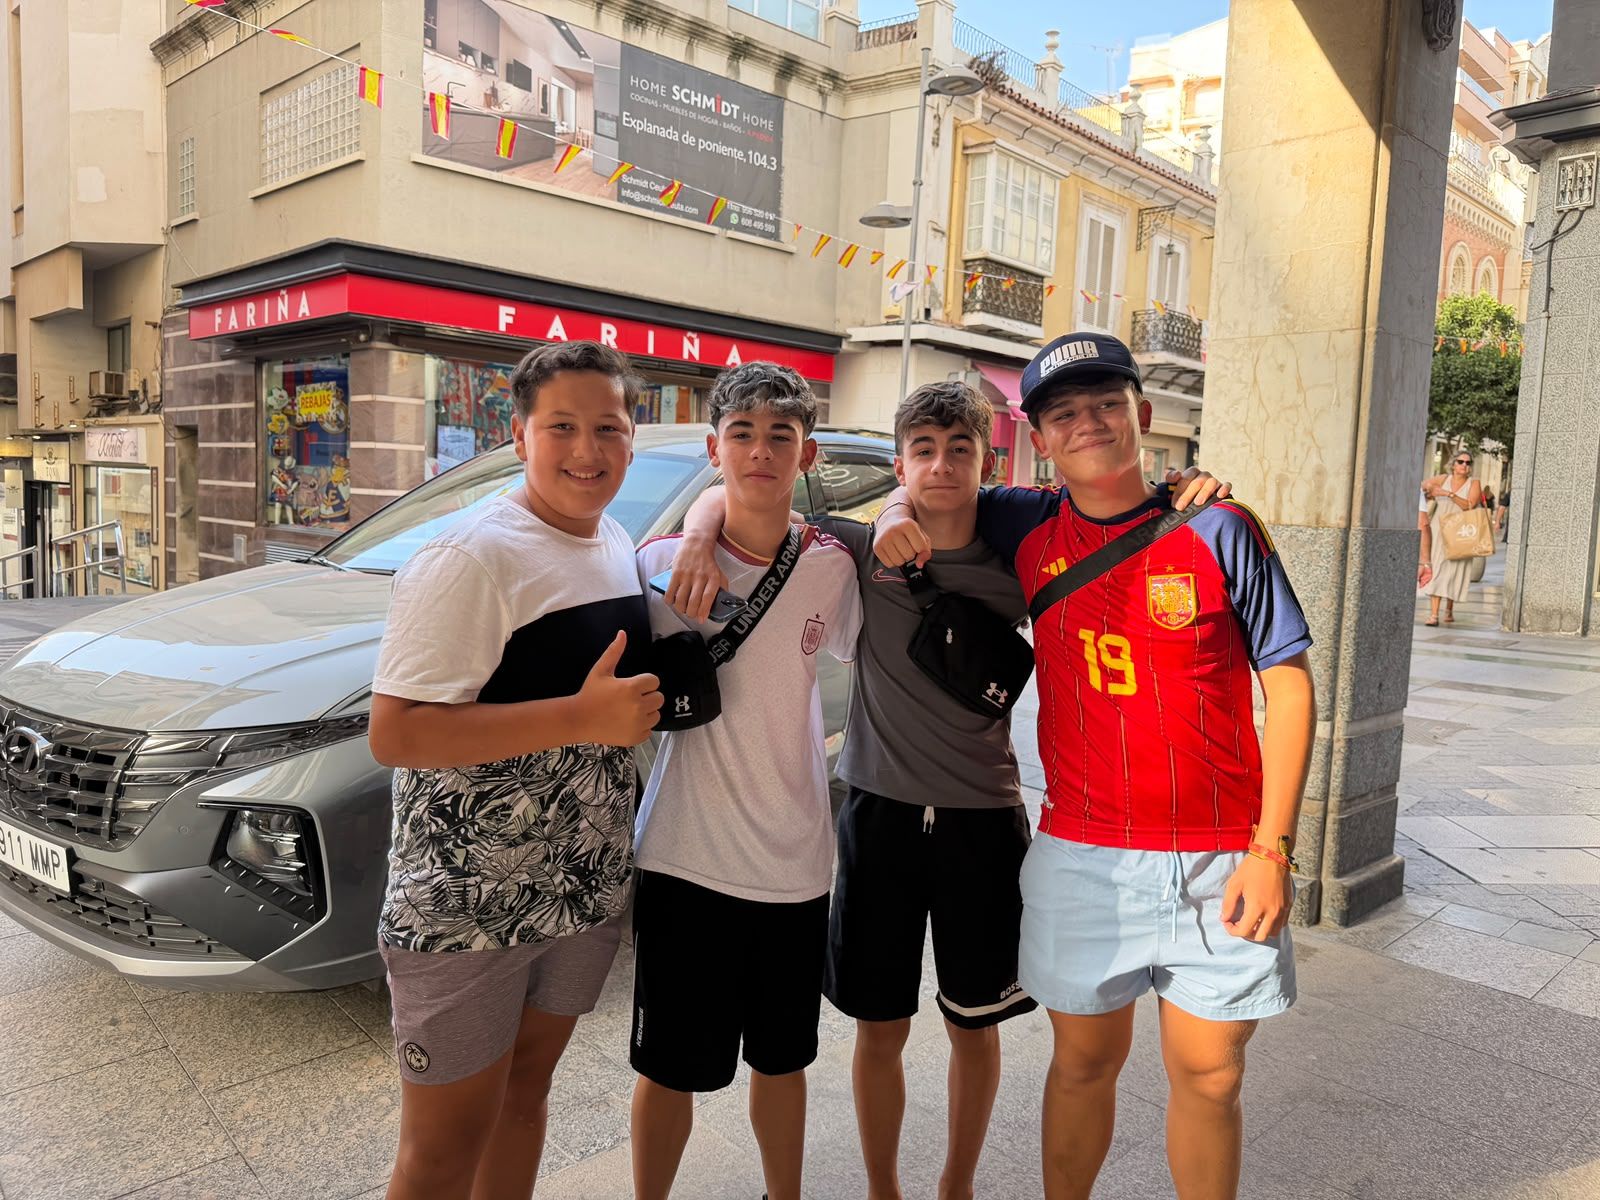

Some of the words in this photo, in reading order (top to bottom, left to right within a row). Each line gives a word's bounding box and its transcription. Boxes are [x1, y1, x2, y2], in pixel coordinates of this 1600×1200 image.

[630, 75, 667, 97] HOME
[742, 112, 775, 132] HOME
[630, 92, 659, 108] COCINAS
[662, 103, 688, 117] MUEBLES
[688, 111, 697, 120] DE
[622, 111, 679, 142] Explanada
[682, 130, 696, 146] de
[748, 149, 778, 172] 104.3
[621, 174, 649, 189] Schmidt
[214, 289, 311, 333] FARIÑA
[498, 304, 742, 367] FARIÑA
[1040, 340, 1099, 375] PUMA
[300, 393, 332, 409] REBAJAS
[732, 576, 780, 635] UNDER
[1078, 628, 1137, 696] 19
[29, 839, 60, 881] MMP
